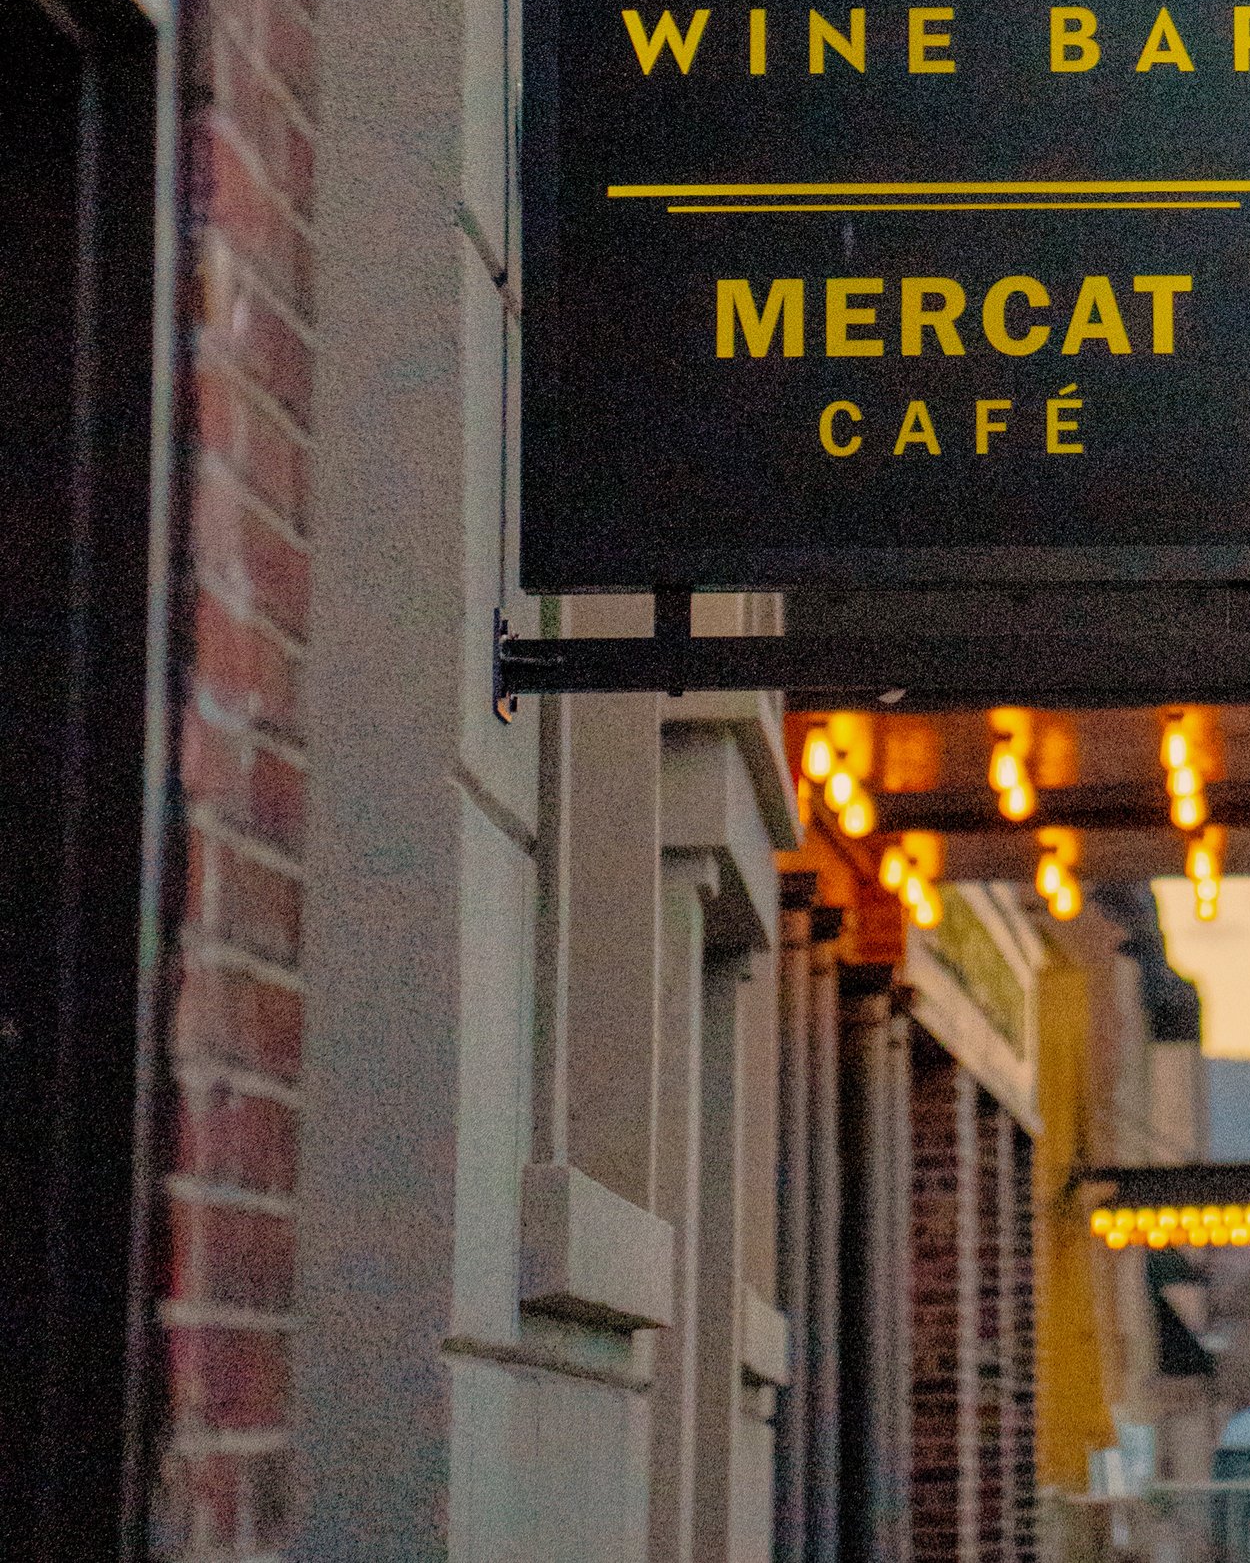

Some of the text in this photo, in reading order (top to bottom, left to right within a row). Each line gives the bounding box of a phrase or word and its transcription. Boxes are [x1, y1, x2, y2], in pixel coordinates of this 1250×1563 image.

[621, 6, 957, 76] WINE
[715, 274, 1194, 359] MERCAT
[818, 382, 1085, 457] CAFÉ
